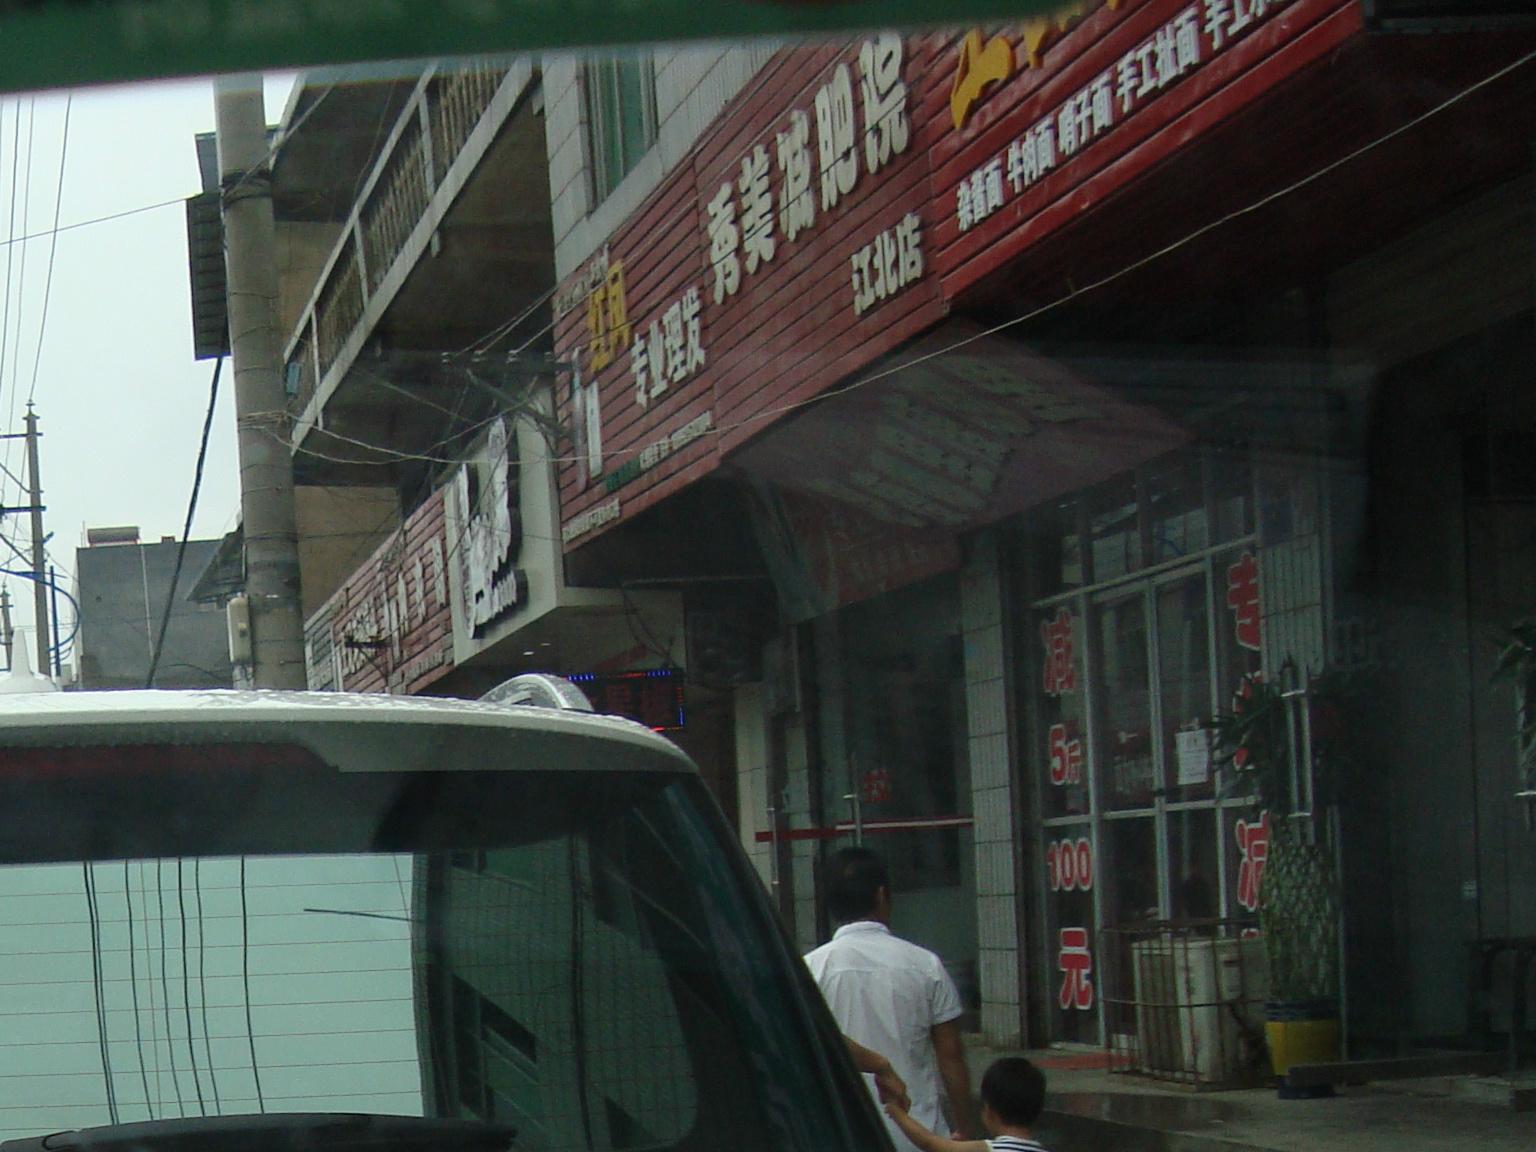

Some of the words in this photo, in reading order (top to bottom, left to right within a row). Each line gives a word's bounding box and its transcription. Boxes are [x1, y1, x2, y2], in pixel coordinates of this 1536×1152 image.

[1204, 0, 1264, 51] 手工
[851, 212, 924, 317] 江北店
[630, 286, 705, 410] 专业理发
